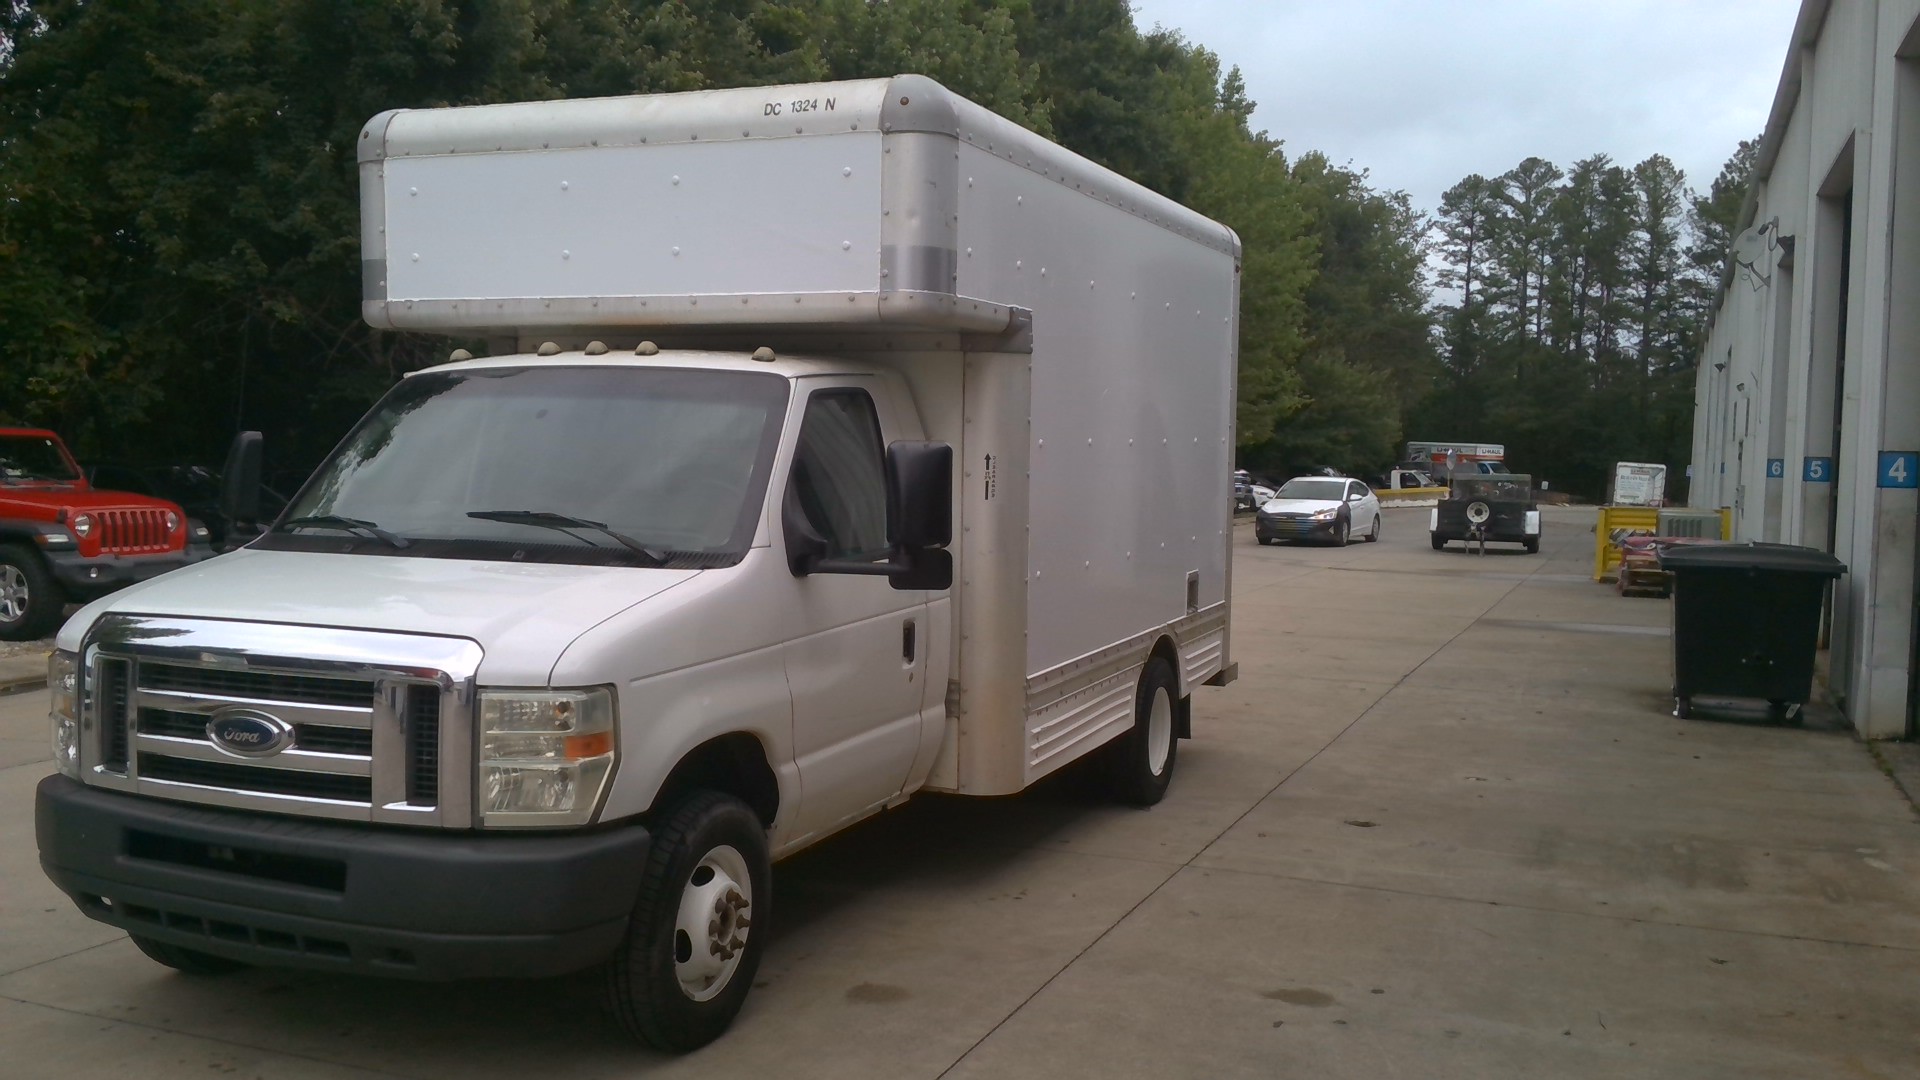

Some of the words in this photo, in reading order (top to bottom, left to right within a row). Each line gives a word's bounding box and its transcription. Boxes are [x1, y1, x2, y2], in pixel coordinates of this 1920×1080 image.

[764, 102, 782, 116] DC
[791, 98, 818, 113] 1324
[825, 97, 836, 111] N
[1771, 461, 1781, 475] 6
[1809, 460, 1823, 479] 5
[1888, 456, 1907, 483] 4
[223, 727, 261, 742] Ford
